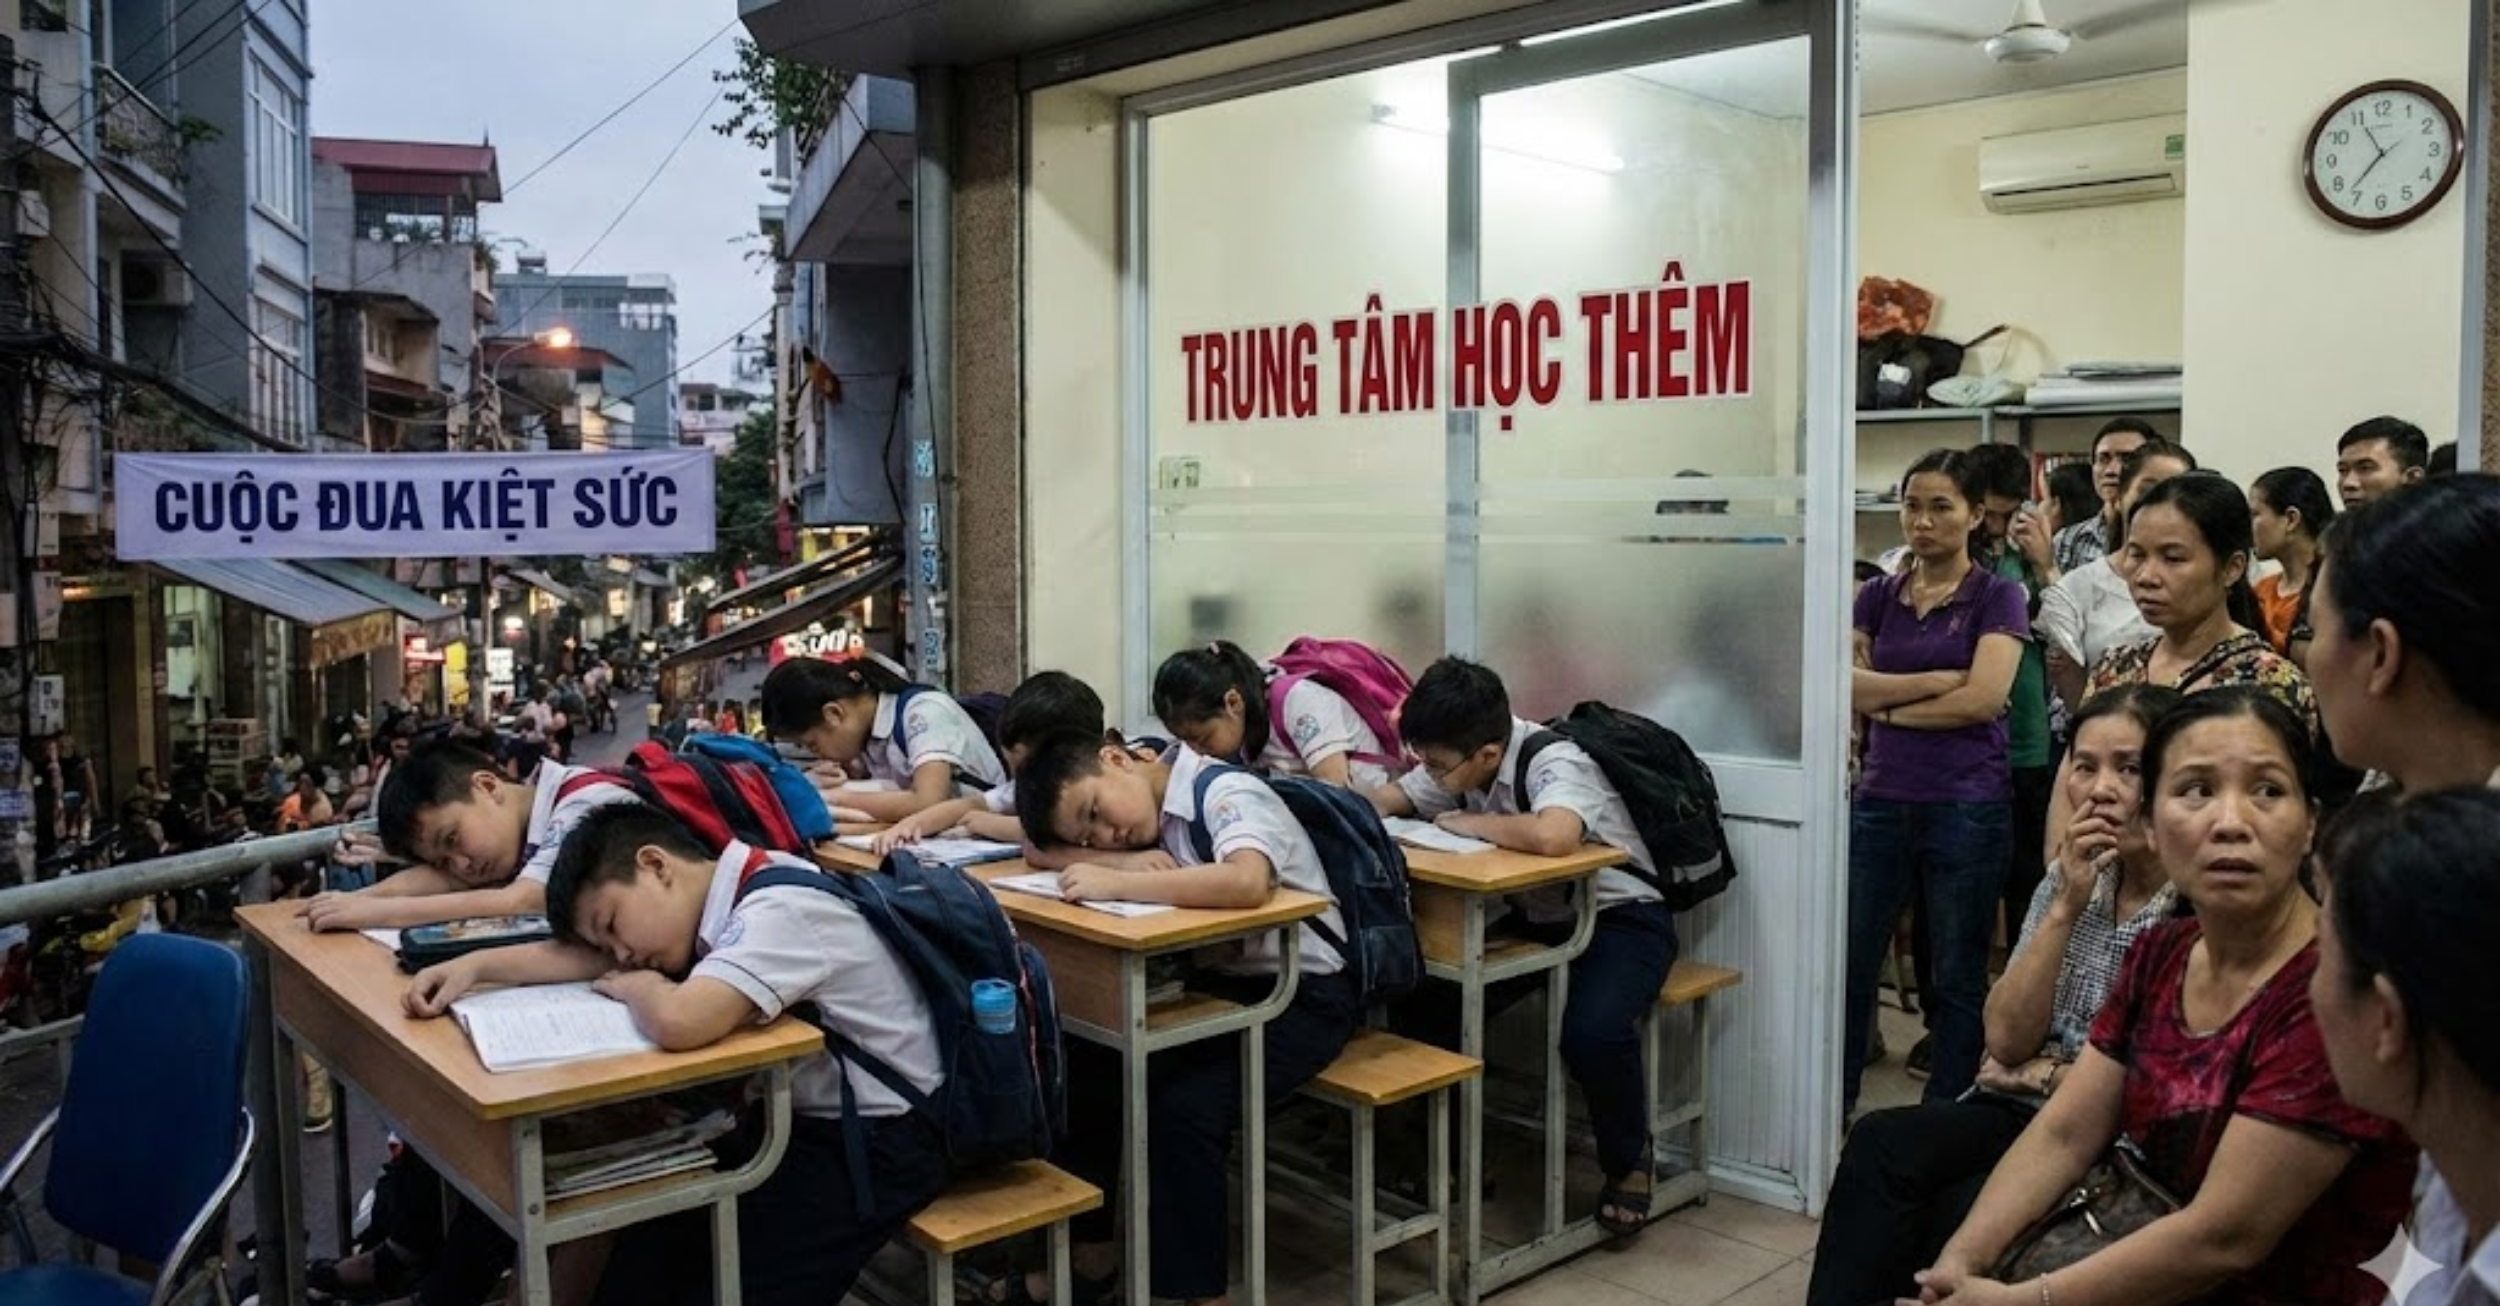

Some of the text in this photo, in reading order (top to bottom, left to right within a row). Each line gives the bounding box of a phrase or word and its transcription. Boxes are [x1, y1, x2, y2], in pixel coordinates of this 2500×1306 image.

[2374, 100, 2392, 118] 12
[2405, 104, 2412, 118] 1
[2351, 110, 2365, 126] 11
[2421, 118, 2434, 135] 2
[2428, 141, 2440, 157] 3
[2419, 166, 2433, 182] 4
[2352, 190, 2363, 206] 7
[2401, 186, 2413, 201] 5
[1181, 260, 1751, 431] TRUNG TÂM HỌC THÊM
[155, 466, 678, 545] CUỘC ĐUA KIỆT SỨC
